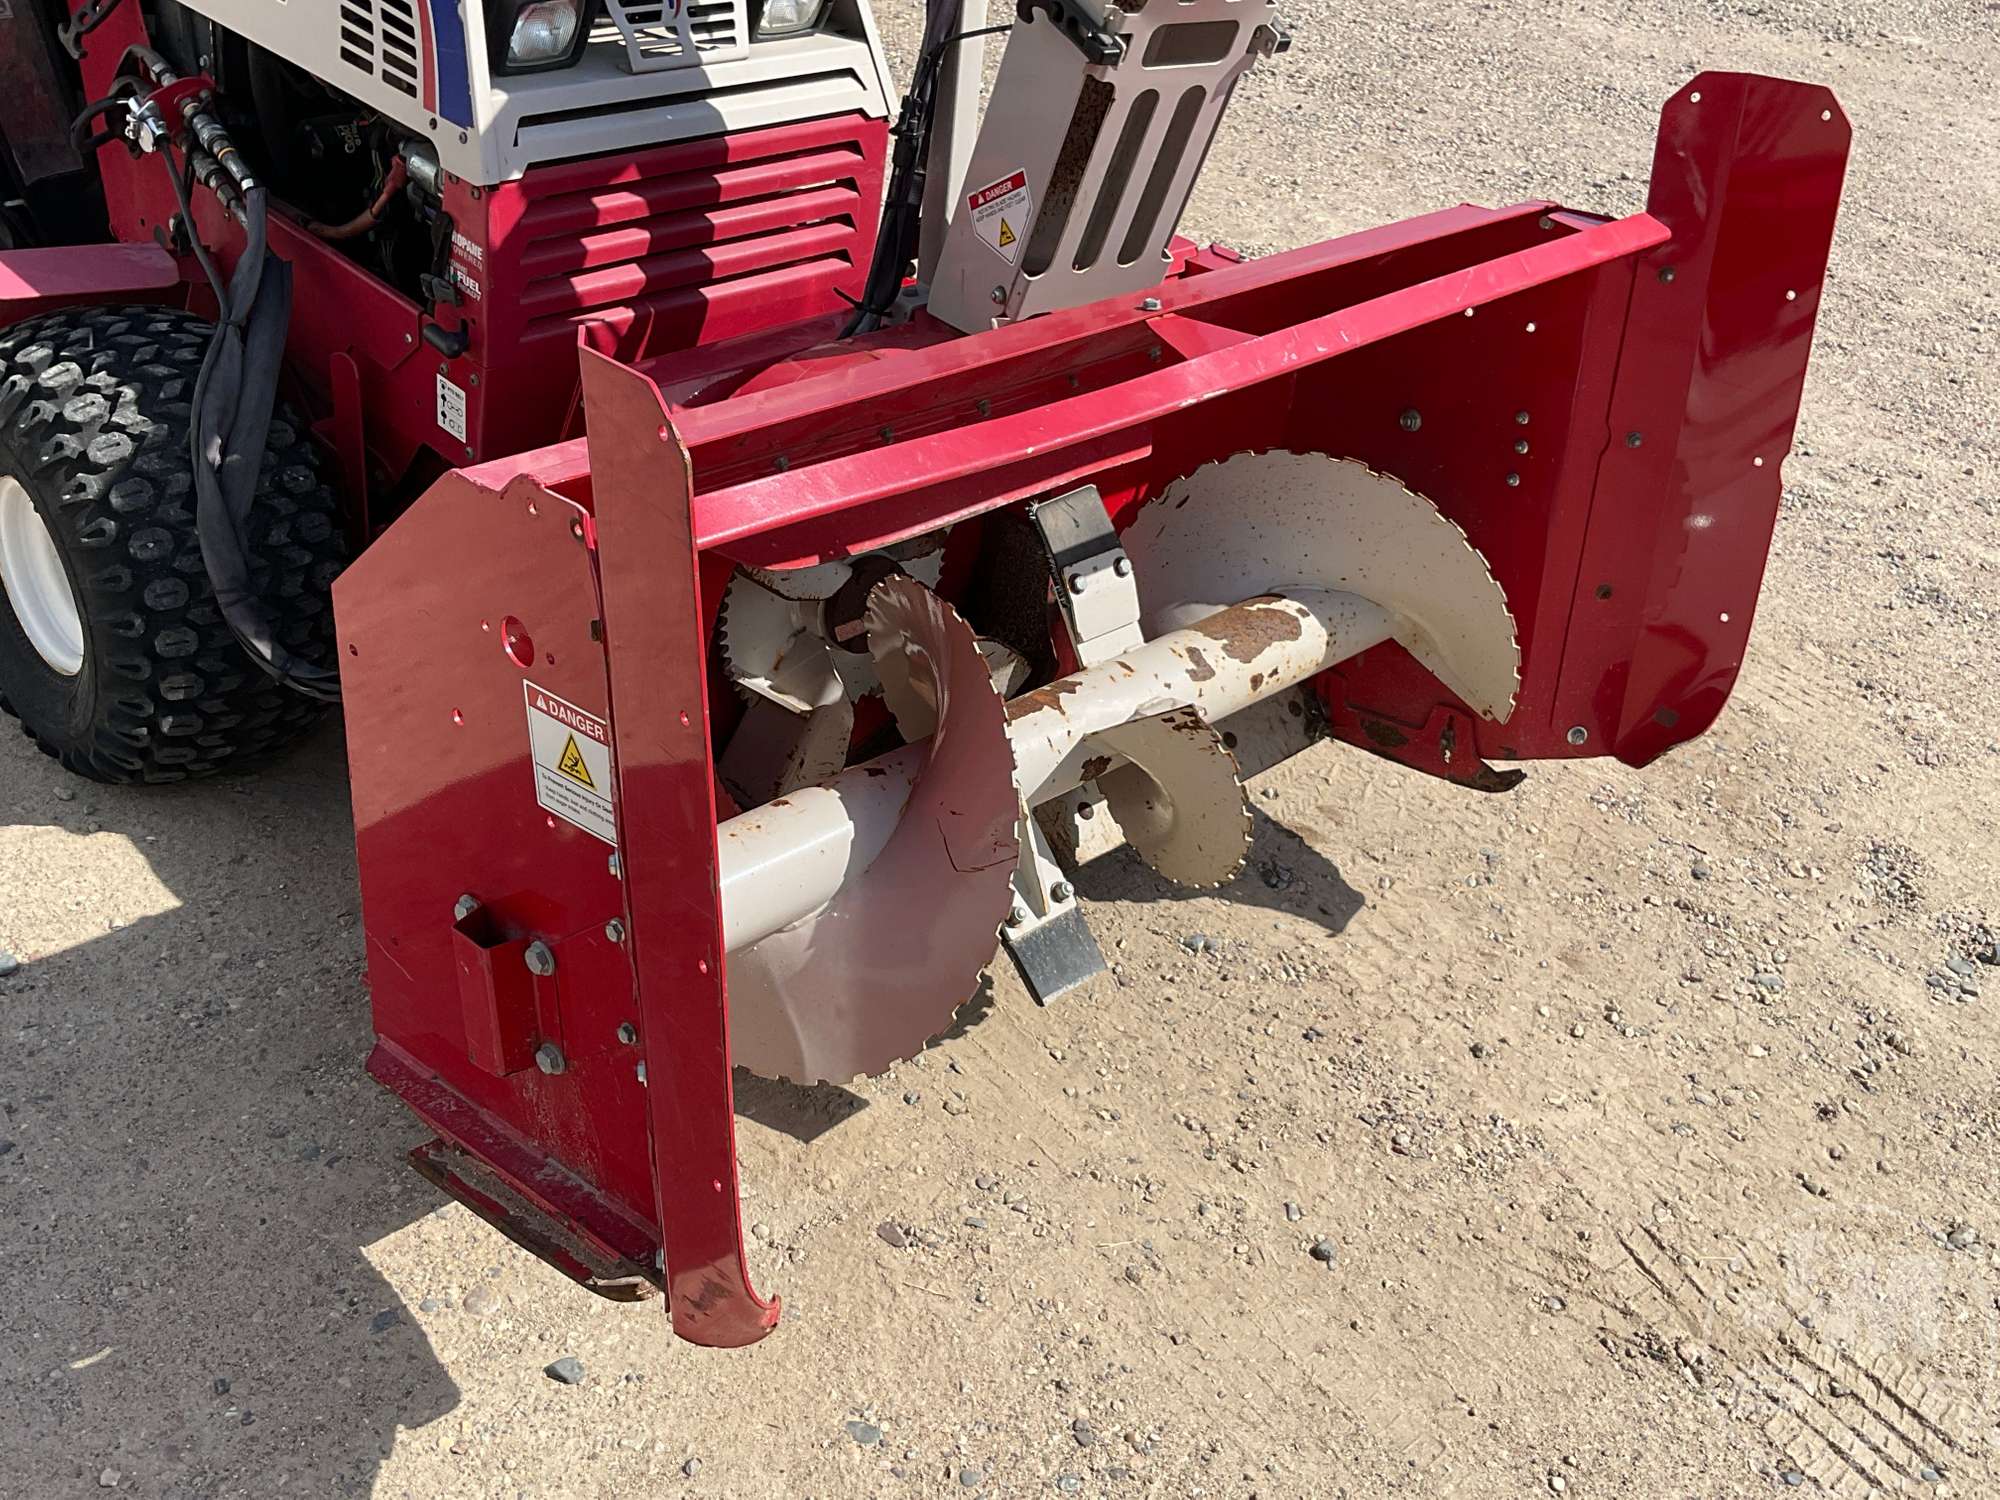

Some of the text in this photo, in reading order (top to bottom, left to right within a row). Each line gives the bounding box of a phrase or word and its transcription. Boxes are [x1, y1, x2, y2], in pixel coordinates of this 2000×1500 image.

[985, 180, 1013, 201] DANGER
[452, 230, 483, 260] ROPANE
[453, 244, 483, 272] OWERED
[457, 270, 482, 296] FUEL
[548, 700, 605, 741] DANGER
